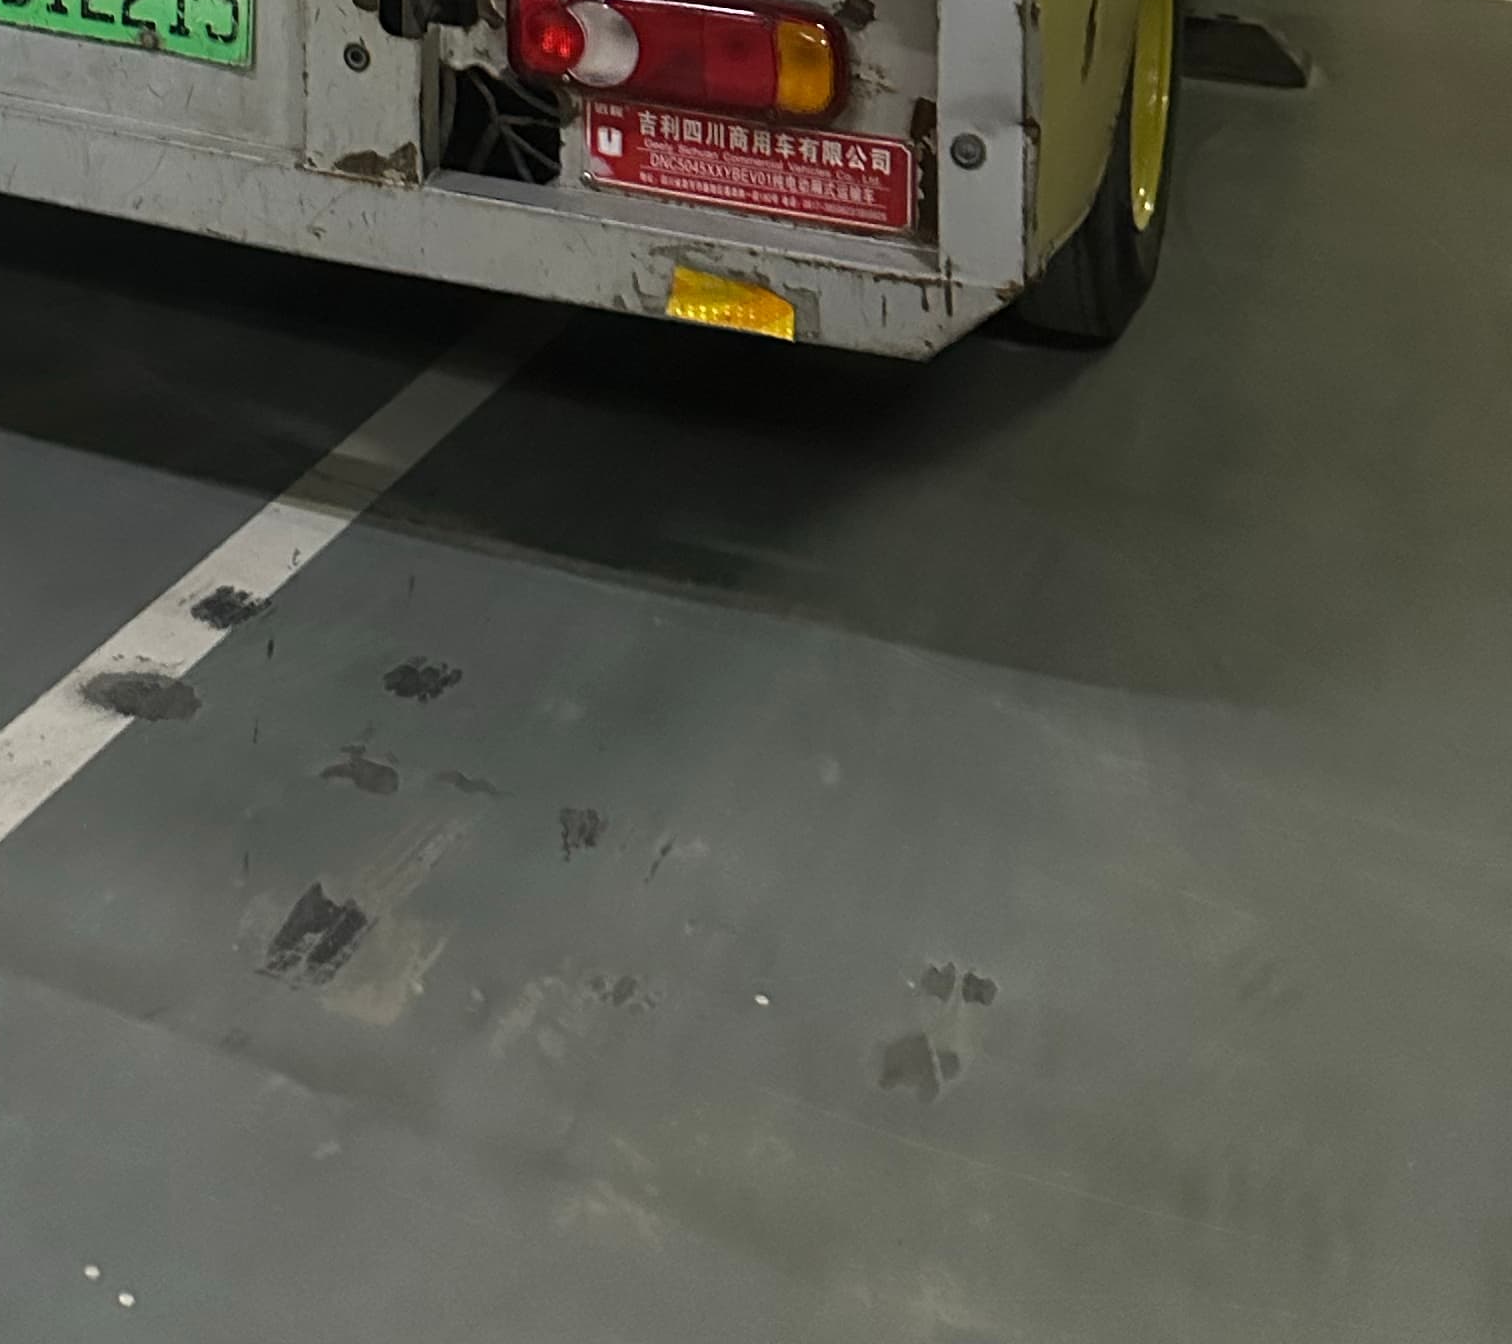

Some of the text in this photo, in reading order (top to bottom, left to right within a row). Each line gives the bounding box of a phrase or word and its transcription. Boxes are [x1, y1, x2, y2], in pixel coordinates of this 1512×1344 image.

[637, 110, 892, 175] 吉利四川商用车有限公司
